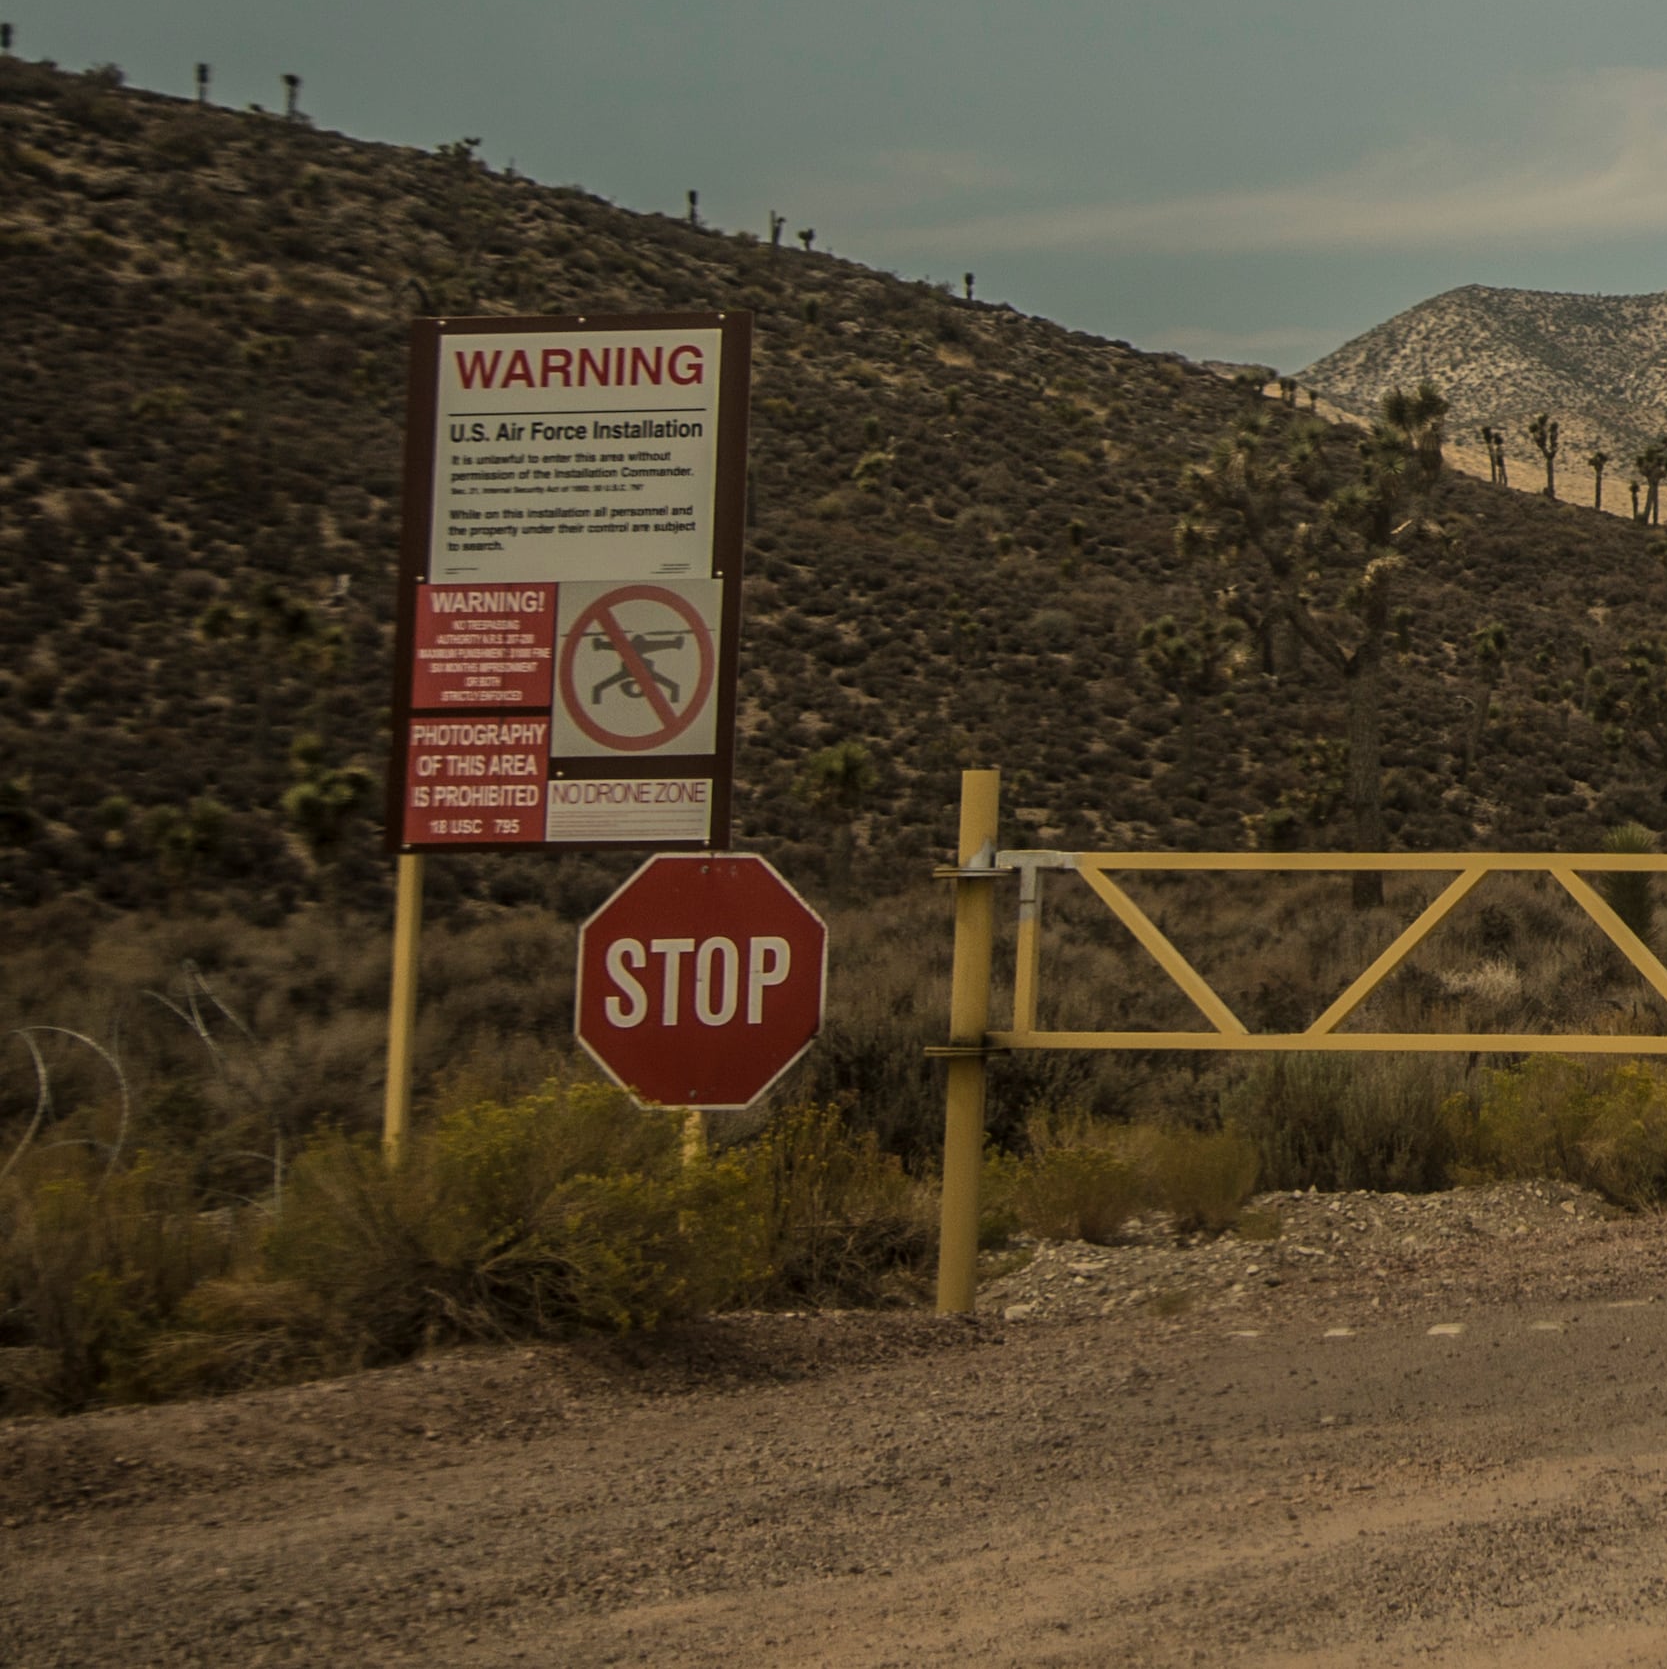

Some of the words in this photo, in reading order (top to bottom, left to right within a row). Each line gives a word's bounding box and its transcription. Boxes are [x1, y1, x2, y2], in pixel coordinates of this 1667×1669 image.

[455, 344, 704, 389] WARNING
[450, 422, 490, 442] U.S.
[496, 422, 525, 441] Air
[531, 421, 587, 441] Force
[593, 419, 703, 439] Installation
[431, 591, 546, 613] WARNING!
[411, 724, 546, 746] PHOTOGRAPHY
[416, 755, 443, 777] OF
[445, 755, 486, 777] THIS
[489, 754, 539, 776] AREA
[412, 785, 431, 808] IS
[432, 784, 539, 807] PROHIBITED
[552, 782, 581, 804] NO
[584, 782, 652, 804] DRONE
[655, 781, 707, 803] ZONE
[430, 819, 448, 834] 18
[450, 819, 483, 834] USC
[494, 818, 521, 834] 795
[605, 935, 791, 1028] STOP
